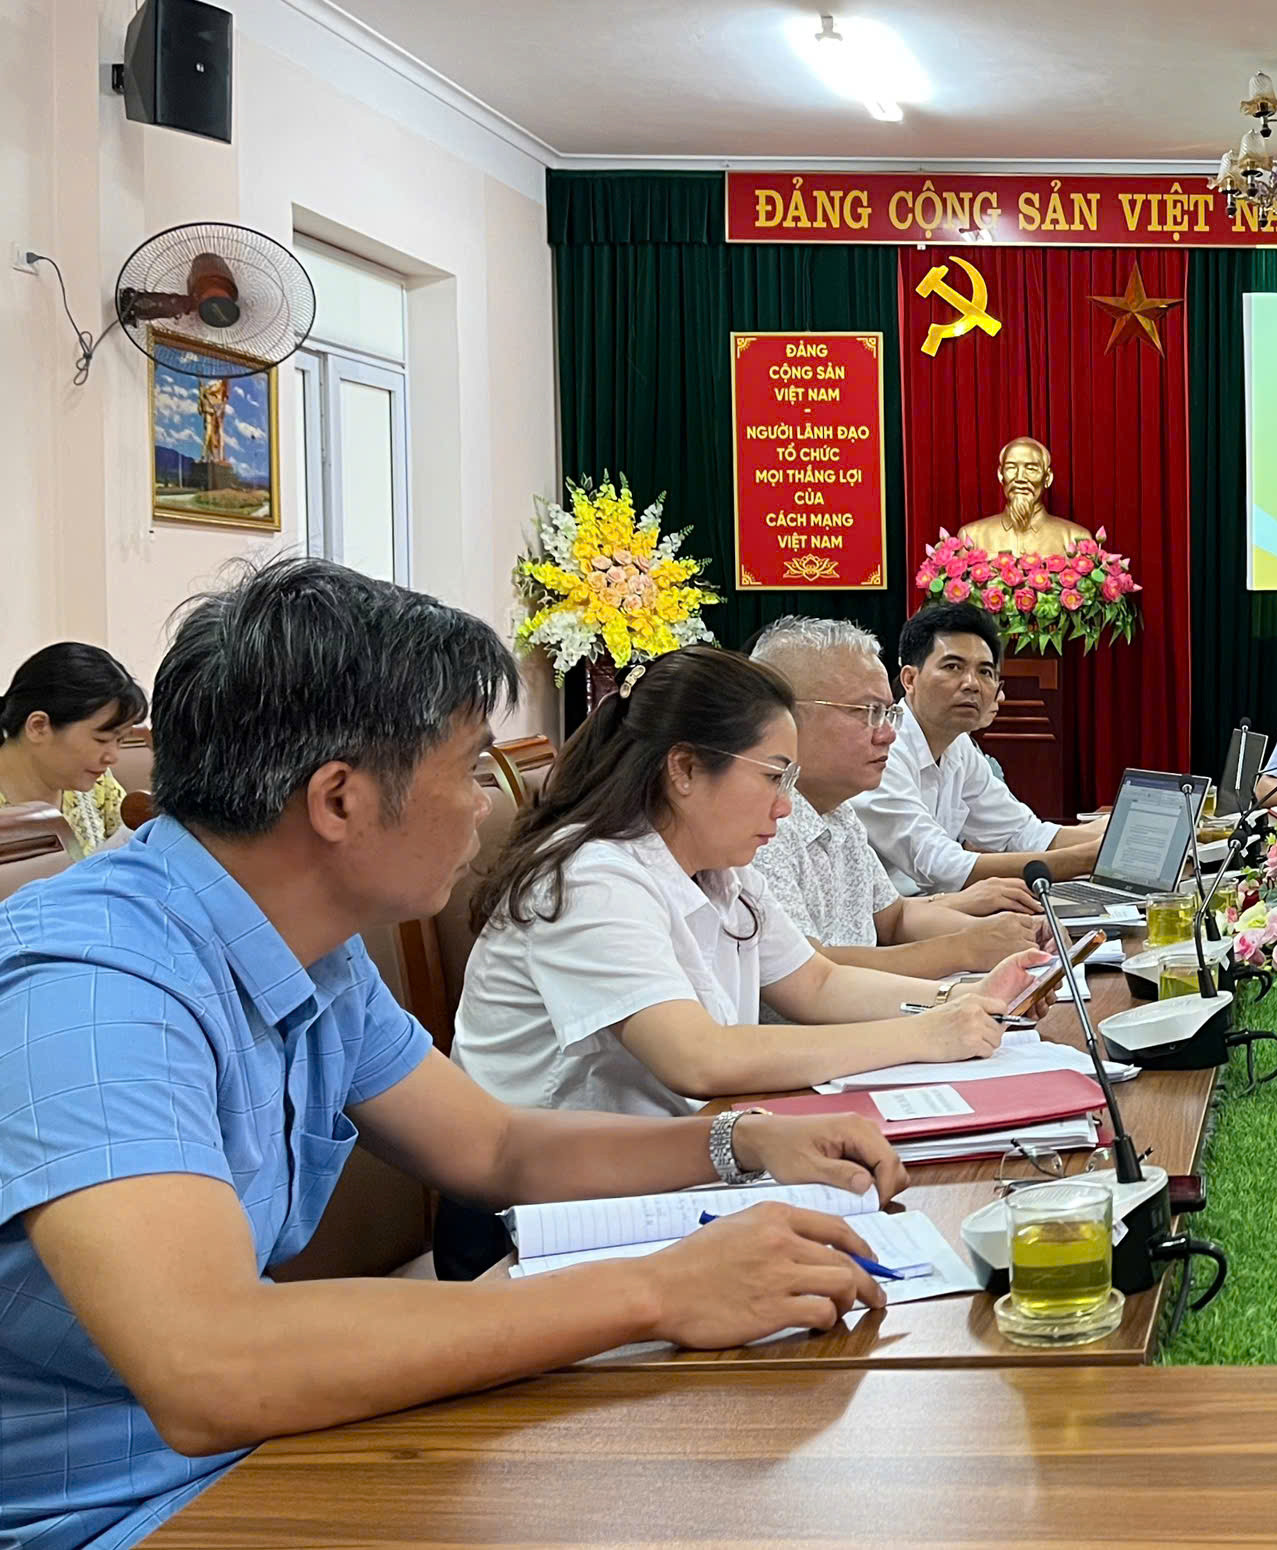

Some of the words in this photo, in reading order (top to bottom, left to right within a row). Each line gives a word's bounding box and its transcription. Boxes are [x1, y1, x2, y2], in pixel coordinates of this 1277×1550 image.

[754, 177, 872, 229] ĐẢNG
[887, 180, 1002, 239] CỘNG
[1018, 180, 1100, 232] SẢN
[1117, 182, 1214, 242] VIỆT
[786, 340, 828, 358] ĐẢNG
[769, 363, 813, 383] CỘNG
[816, 362, 845, 380] SẢN
[774, 385, 805, 405] VIỆT
[808, 388, 840, 401] NAM
[746, 422, 793, 440] NGƯỜI
[797, 423, 833, 439] LÃNH
[837, 426, 870, 443] ĐẠO
[776, 442, 796, 461] TỔ
[800, 445, 840, 461] CHỨC
[755, 469, 783, 487] MỌI
[786, 465, 836, 483] THẮNG
[839, 469, 862, 487] LỢI
[794, 488, 824, 505] CỦA
[765, 510, 806, 527] CÁCH
[810, 513, 854, 530] MẠNG
[777, 532, 808, 552] VIỆT
[811, 535, 843, 548] NAM
